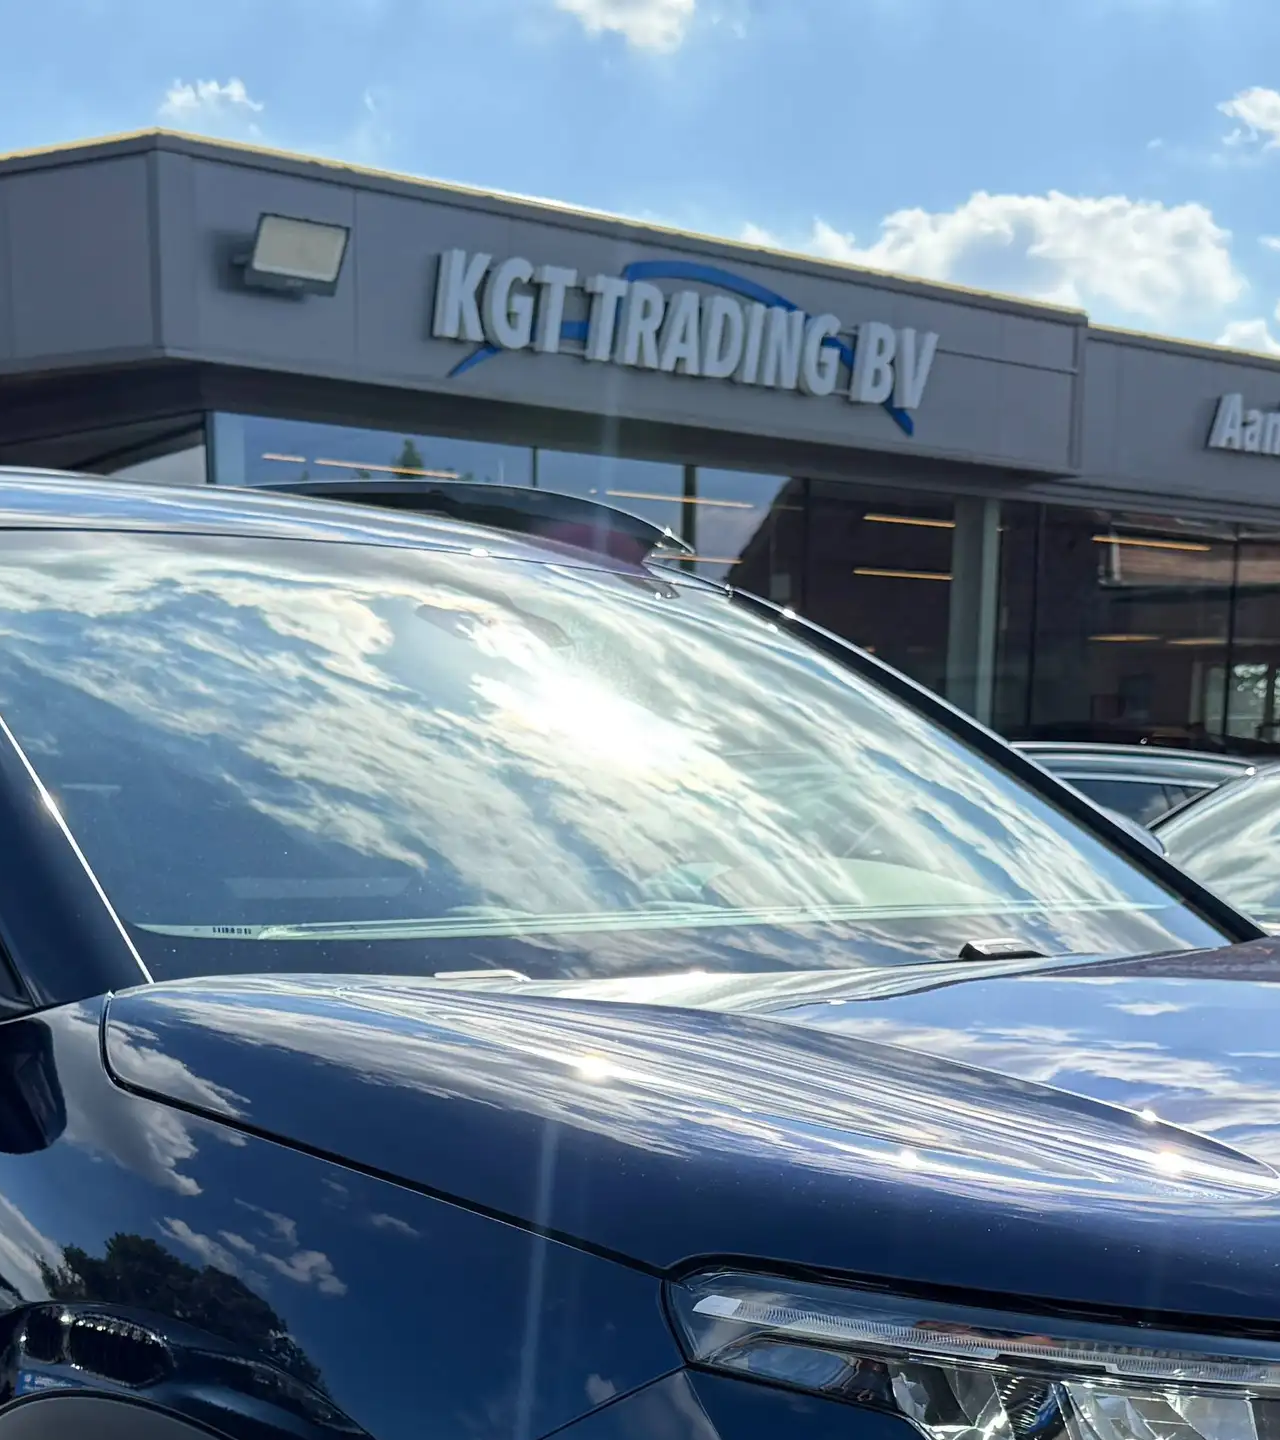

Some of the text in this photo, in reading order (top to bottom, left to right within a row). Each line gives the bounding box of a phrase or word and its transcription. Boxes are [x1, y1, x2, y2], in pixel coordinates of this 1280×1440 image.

[432, 249, 939, 410] KGT TRADING BV
